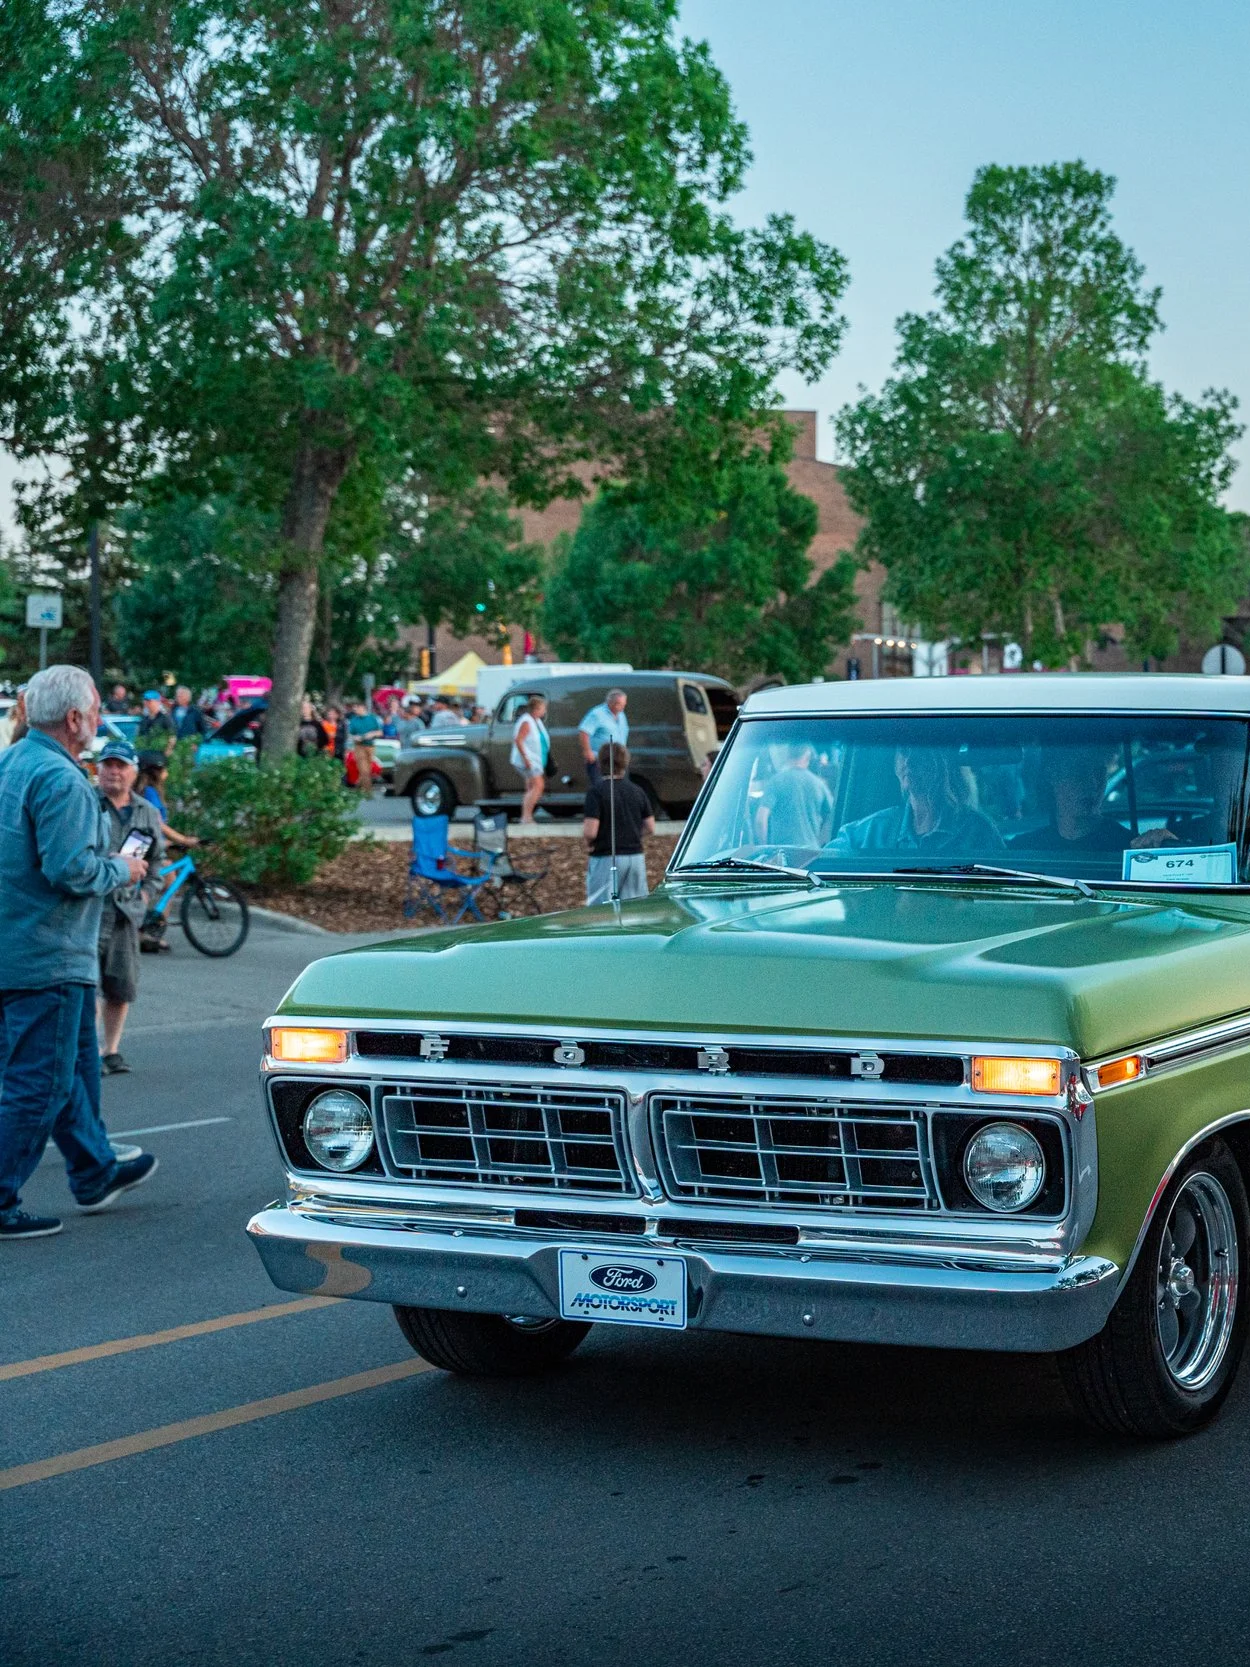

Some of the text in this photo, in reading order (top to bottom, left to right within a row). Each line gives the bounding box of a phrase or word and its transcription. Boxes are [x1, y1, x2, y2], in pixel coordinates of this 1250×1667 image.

[1165, 859, 1194, 869] 674
[420, 1039, 885, 1075] FORD
[602, 1267, 645, 1289] Ford
[570, 1292, 678, 1315] MOTORSPORT
